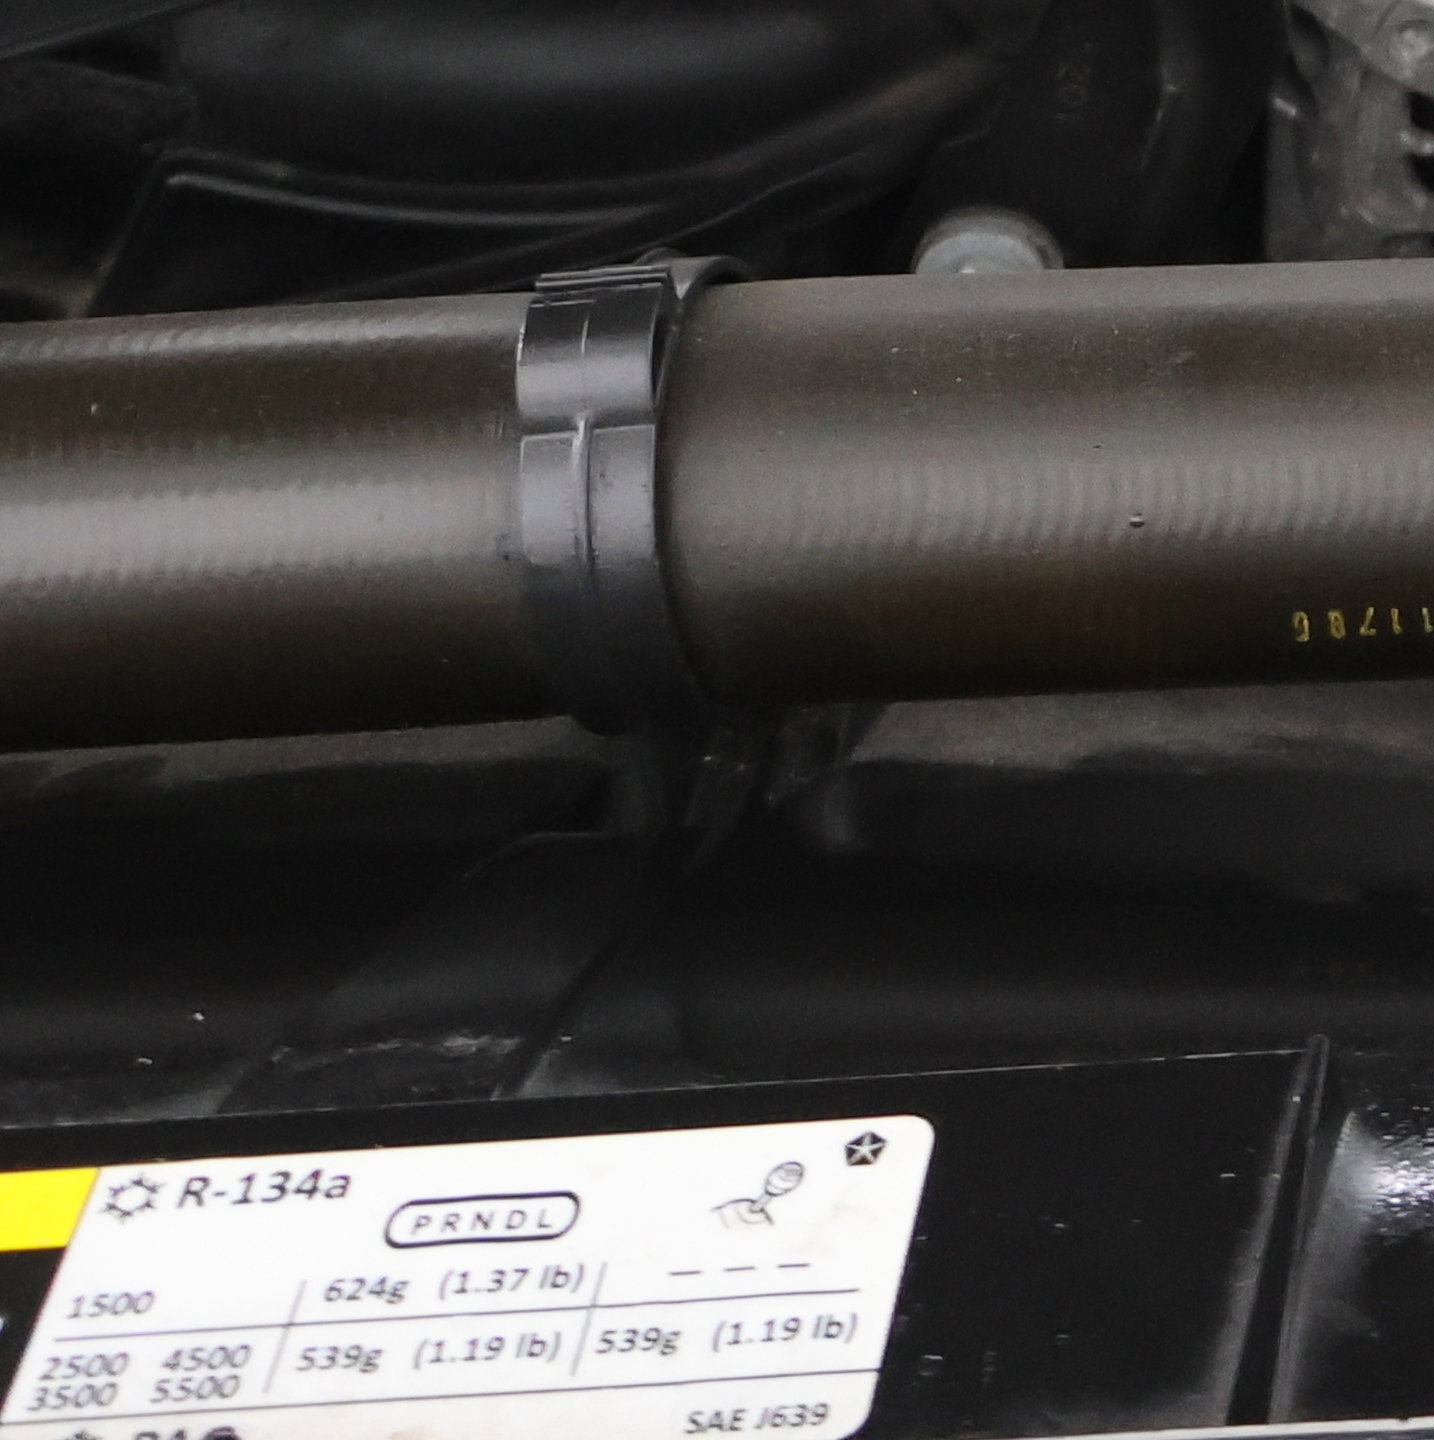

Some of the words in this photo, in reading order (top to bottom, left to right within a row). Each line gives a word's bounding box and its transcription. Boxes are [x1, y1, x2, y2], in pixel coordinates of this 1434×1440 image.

[177, 1168, 352, 1208] R-134a
[324, 1276, 410, 1303] 624g
[438, 1268, 530, 1301] (1.37
[539, 1263, 585, 1294] lb)
[67, 1290, 156, 1320] 1500
[296, 1344, 385, 1374] 539g
[413, 1334, 504, 1370] (1.19
[515, 1330, 562, 1362] lb)
[595, 1326, 683, 1356] 539g
[711, 1317, 801, 1354] (1.19
[811, 1312, 860, 1344] lb)
[39, 1352, 130, 1381] 2500
[162, 1344, 251, 1371] 4500
[26, 1382, 118, 1412] 3500
[150, 1374, 241, 1404] 5500
[684, 1407, 748, 1436] SAE
[755, 1402, 831, 1431] J639
